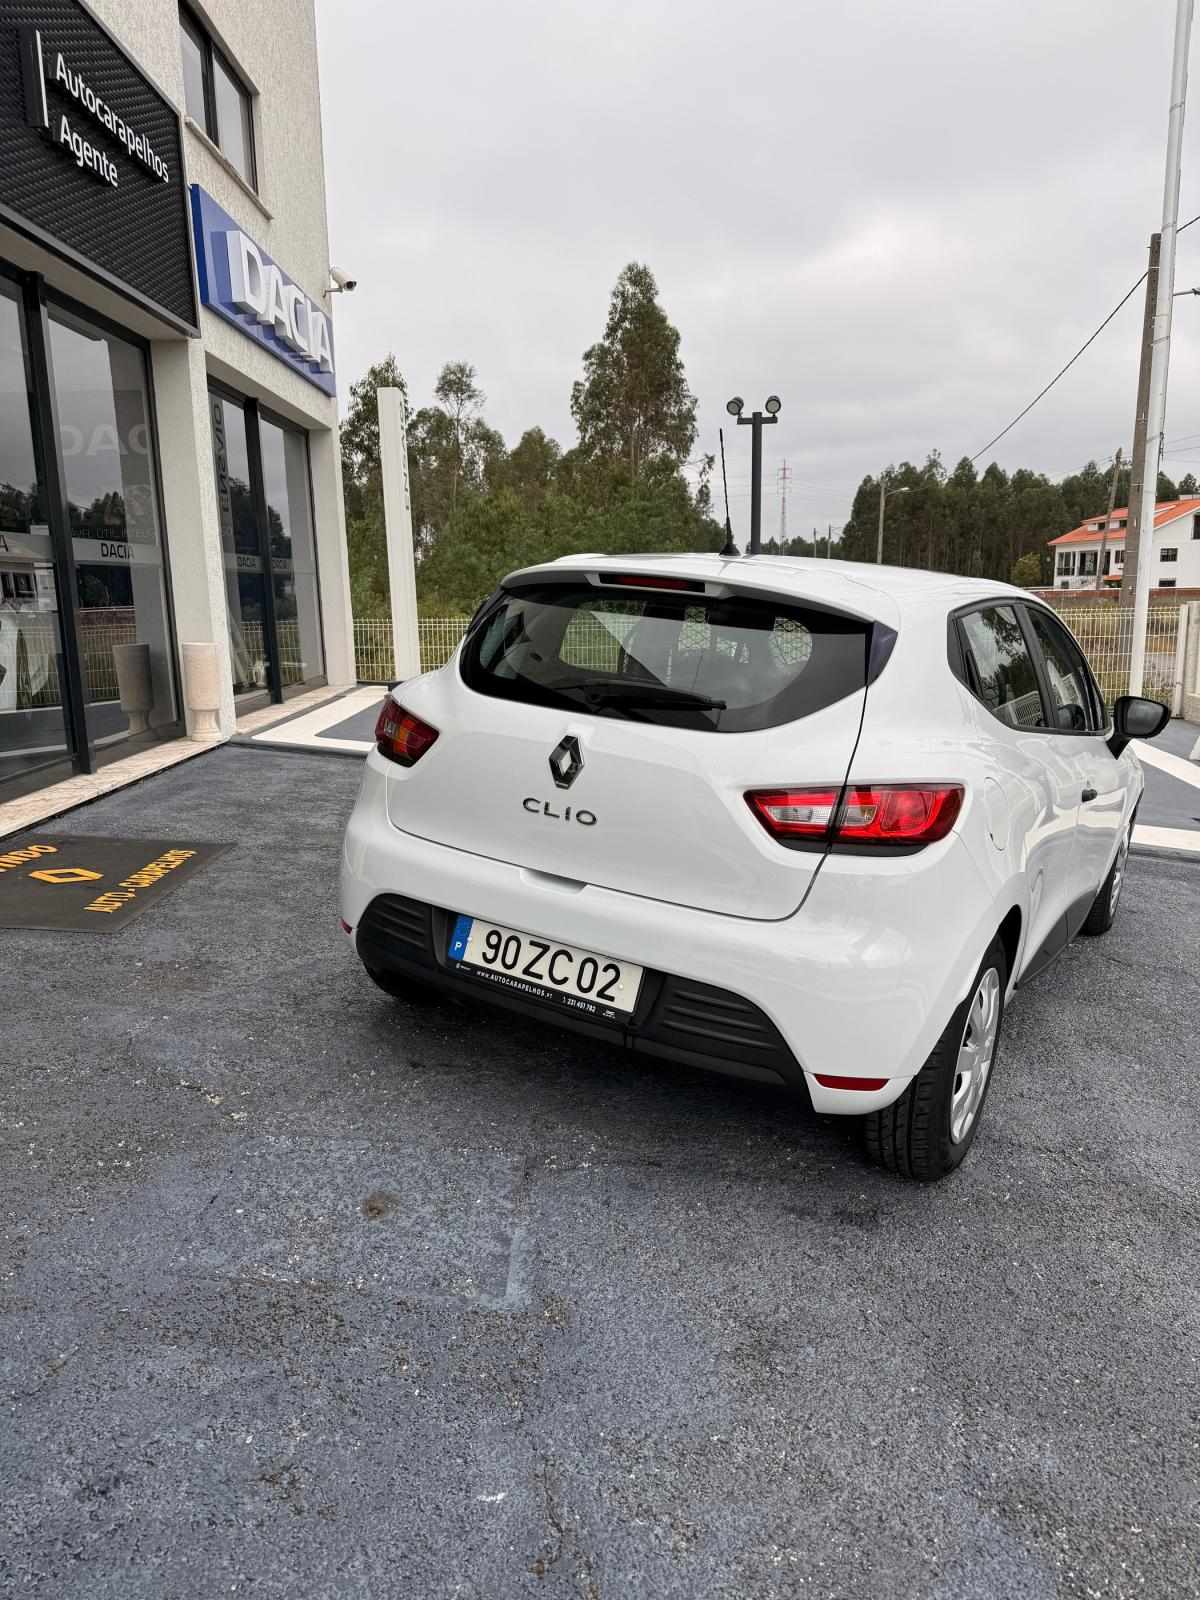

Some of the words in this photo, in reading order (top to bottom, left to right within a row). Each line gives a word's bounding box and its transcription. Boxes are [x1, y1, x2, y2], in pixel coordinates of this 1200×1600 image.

[56, 53, 169, 183] Autocarapelhos
[60, 115, 118, 187] Agente
[226, 230, 333, 374] DACIA
[101, 542, 135, 560] DACIA
[522, 797, 597, 826] CLIO
[454, 941, 463, 951] P
[482, 929, 621, 1002] 90ZC02
